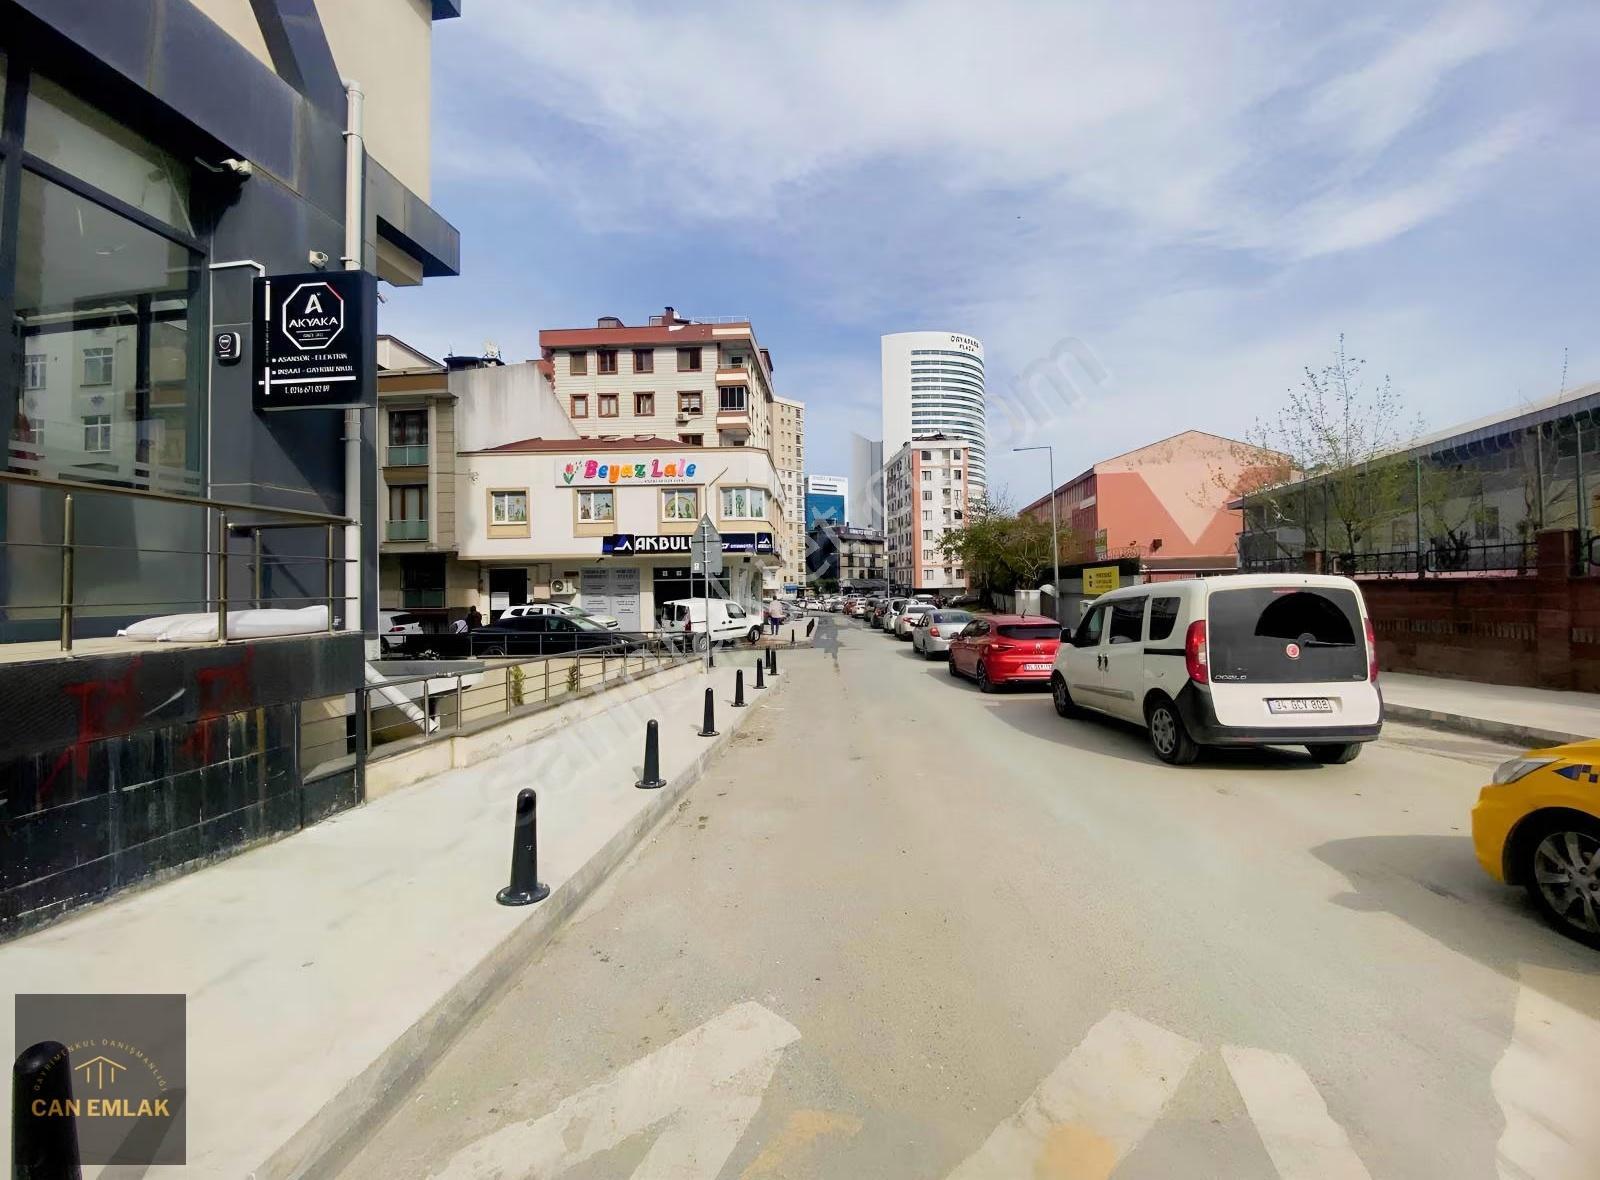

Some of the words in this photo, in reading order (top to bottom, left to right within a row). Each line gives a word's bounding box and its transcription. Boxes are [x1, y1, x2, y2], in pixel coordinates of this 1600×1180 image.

[288, 316, 340, 329] AKYAKA
[583, 459, 646, 484] Beyaz
[650, 458, 696, 478] Lale
